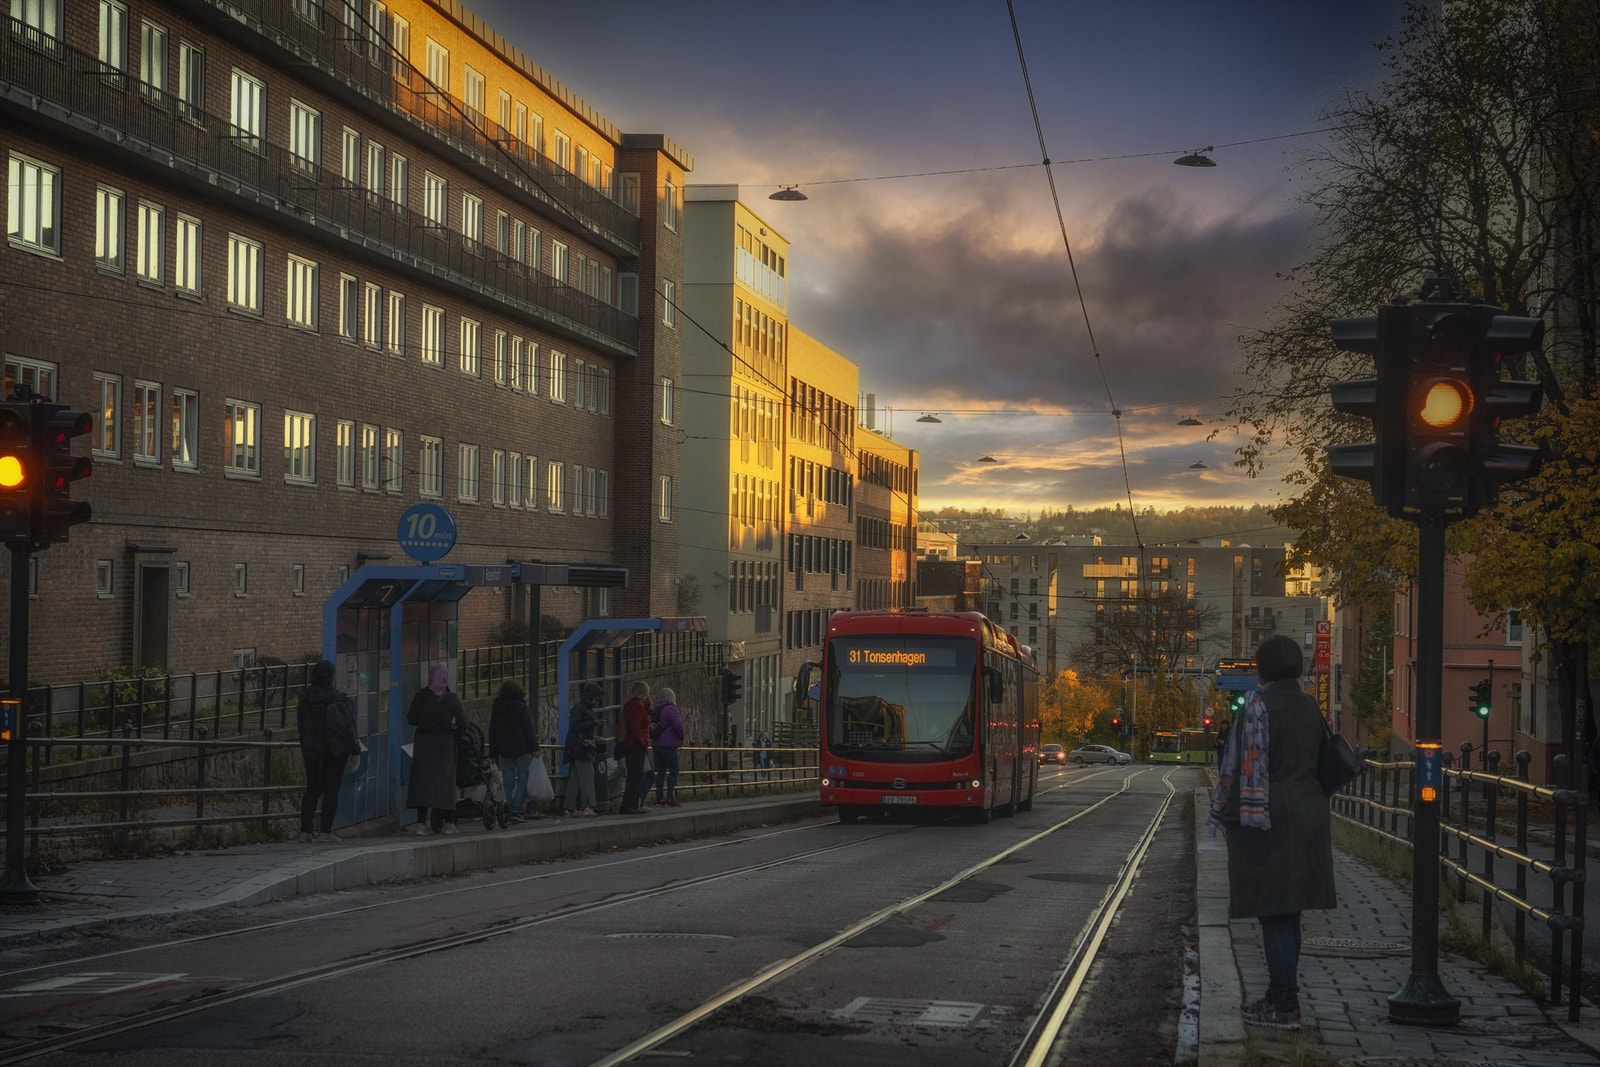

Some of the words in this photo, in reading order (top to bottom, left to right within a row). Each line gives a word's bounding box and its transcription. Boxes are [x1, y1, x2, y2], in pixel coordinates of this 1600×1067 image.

[406, 513, 437, 539] 10
[433, 531, 452, 539] min
[849, 650, 861, 663] 31
[863, 650, 926, 666] Tonsenhagen
